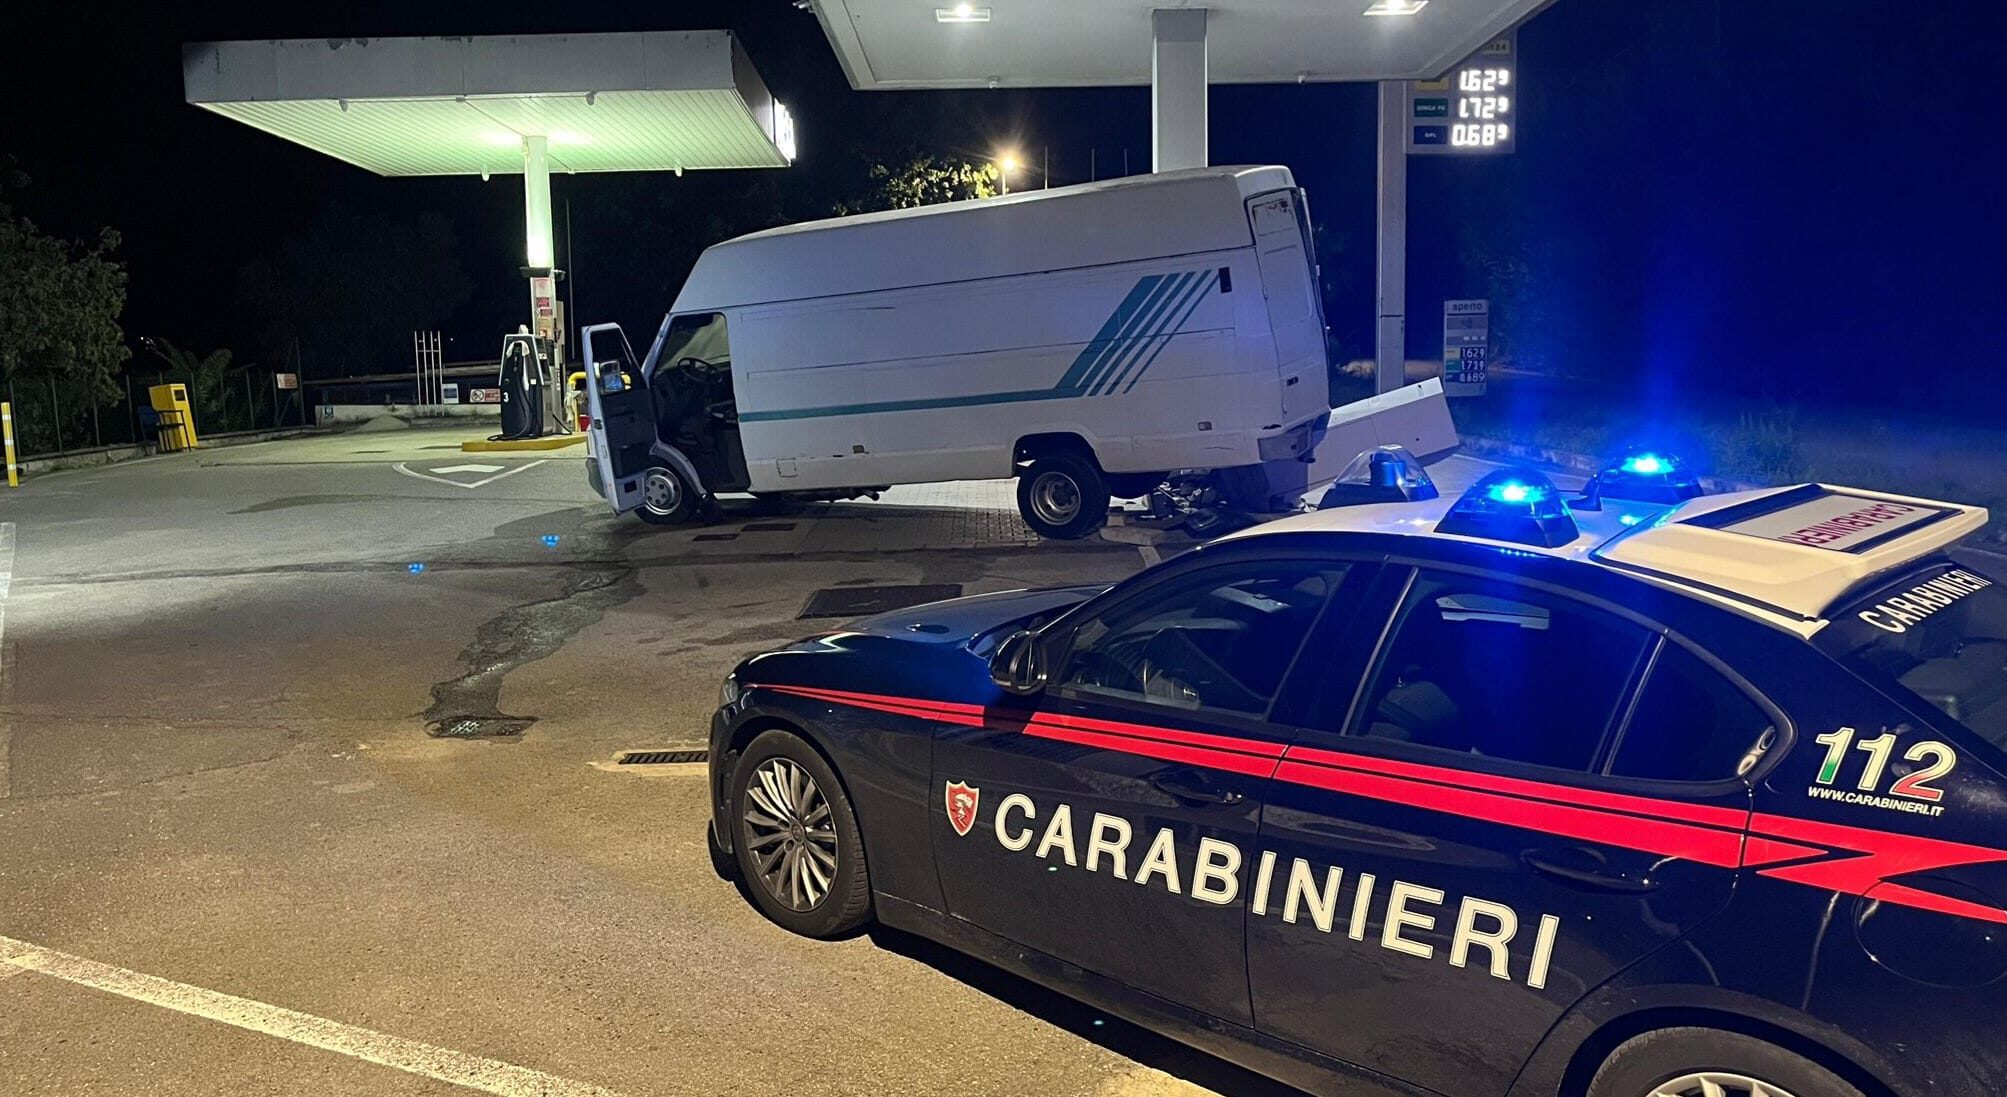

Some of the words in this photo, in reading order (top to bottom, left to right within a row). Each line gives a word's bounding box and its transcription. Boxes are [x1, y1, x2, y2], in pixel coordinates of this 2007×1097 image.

[503, 391, 509, 402] 3
[1859, 569, 1992, 633] CARABINIERI
[1815, 726, 1957, 802] 112
[1808, 786, 1945, 817] WWW.CARABINIERI.IT
[994, 793, 1560, 989] CARABINIERI
